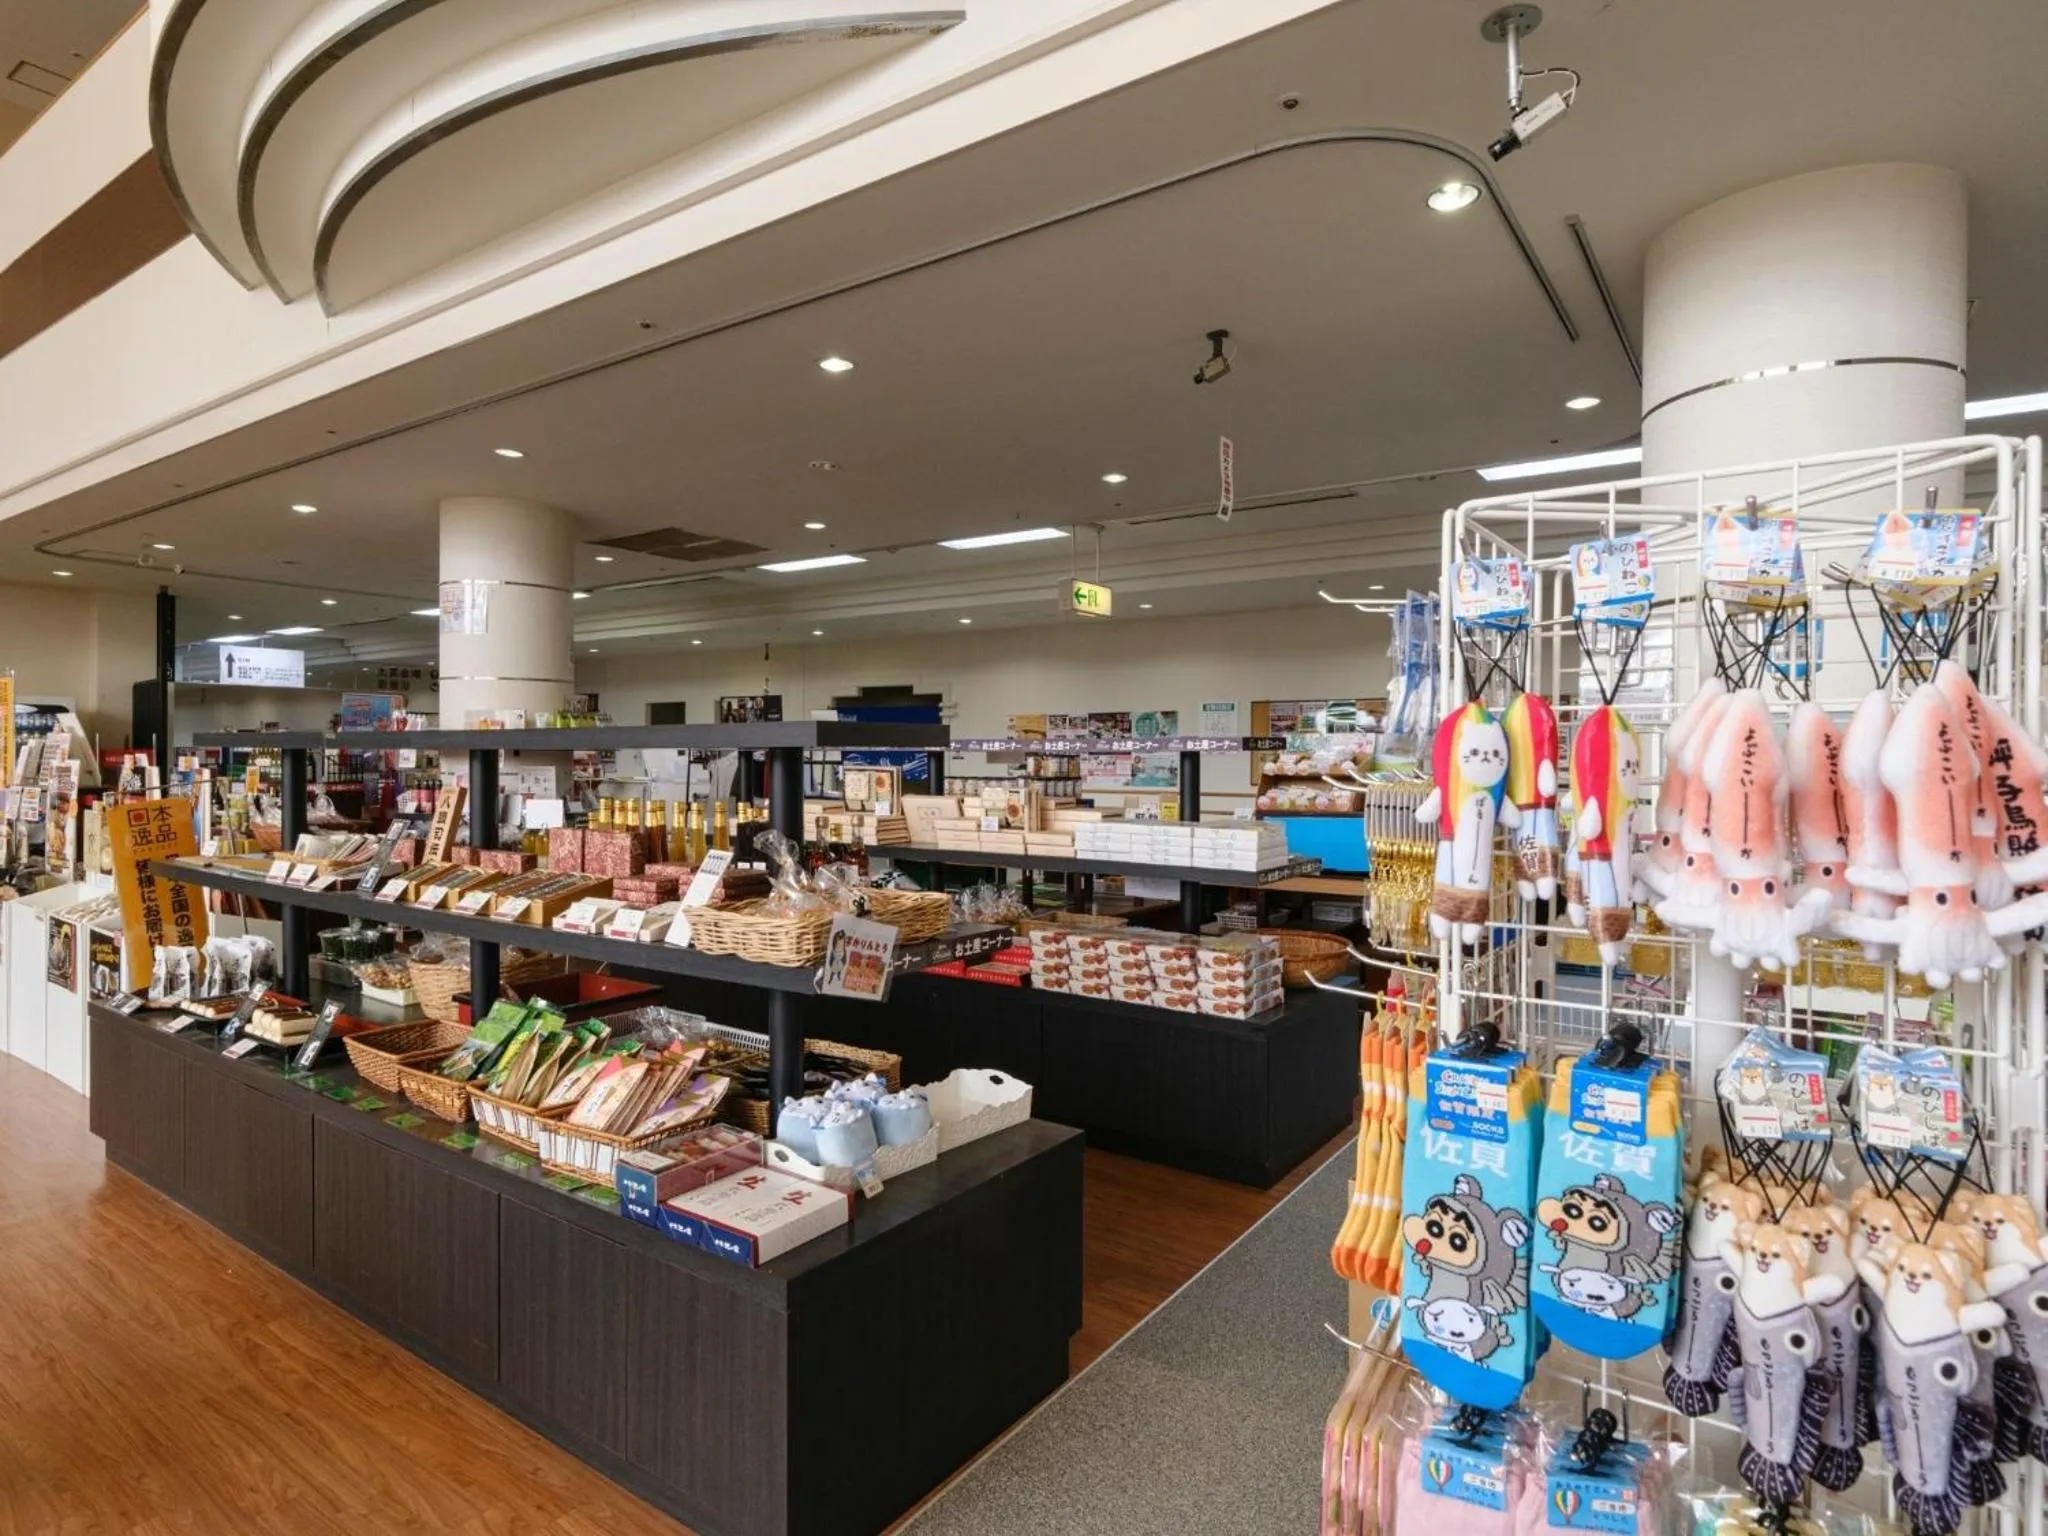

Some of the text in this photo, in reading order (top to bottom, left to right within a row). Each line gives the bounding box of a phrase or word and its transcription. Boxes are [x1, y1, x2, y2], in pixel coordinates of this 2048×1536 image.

[131, 824, 177, 847] 逸品
[1519, 834, 1539, 872] 佐賀
[955, 933, 1011, 957] お土産コーナー
[1561, 1132, 1657, 1181] 佐賀
